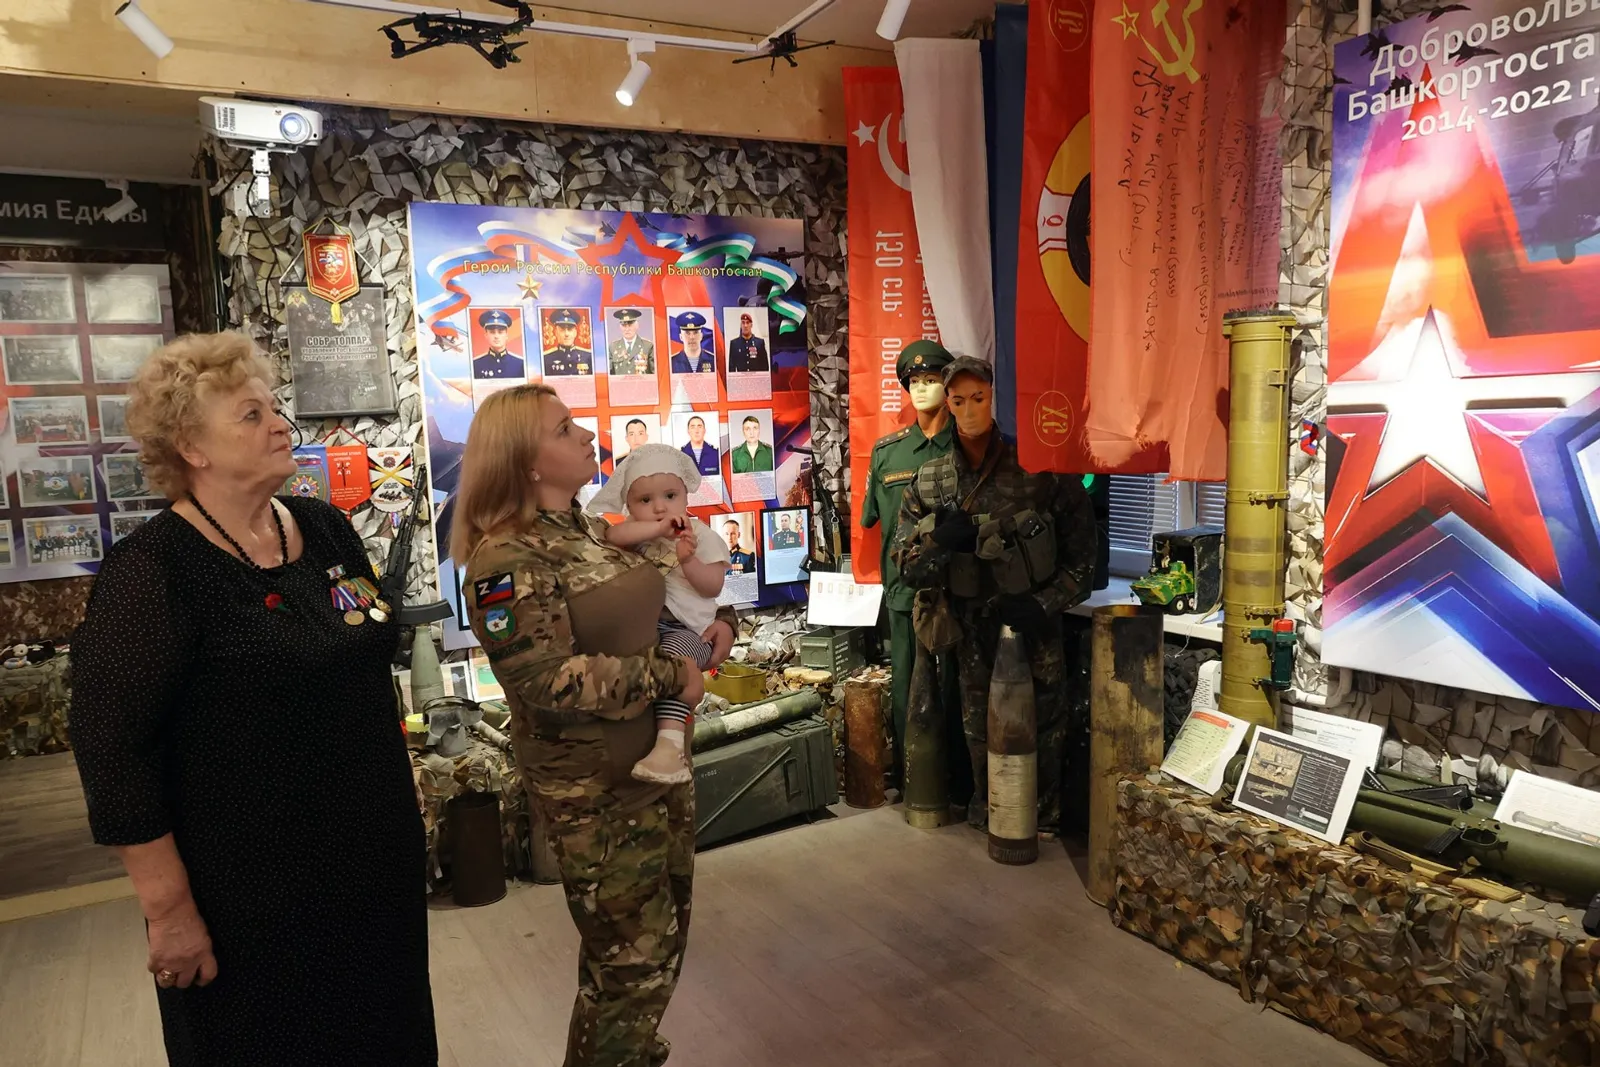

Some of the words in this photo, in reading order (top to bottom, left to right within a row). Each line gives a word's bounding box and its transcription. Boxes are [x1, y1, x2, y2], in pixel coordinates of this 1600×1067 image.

[1370, 0, 1600, 86] Доброволь
[1348, 32, 1595, 121] Башкортоста
[1401, 79, 1572, 141] 2014-2022
[1580, 76, 1600, 97] г.
[56, 199, 147, 226] Едиы
[463, 259, 510, 275] Герои
[516, 259, 571, 274] России
[577, 262, 662, 279] Республики
[667, 264, 763, 279] Башкортостан
[307, 336, 330, 346] СОБР
[478, 582, 490, 596] Z
